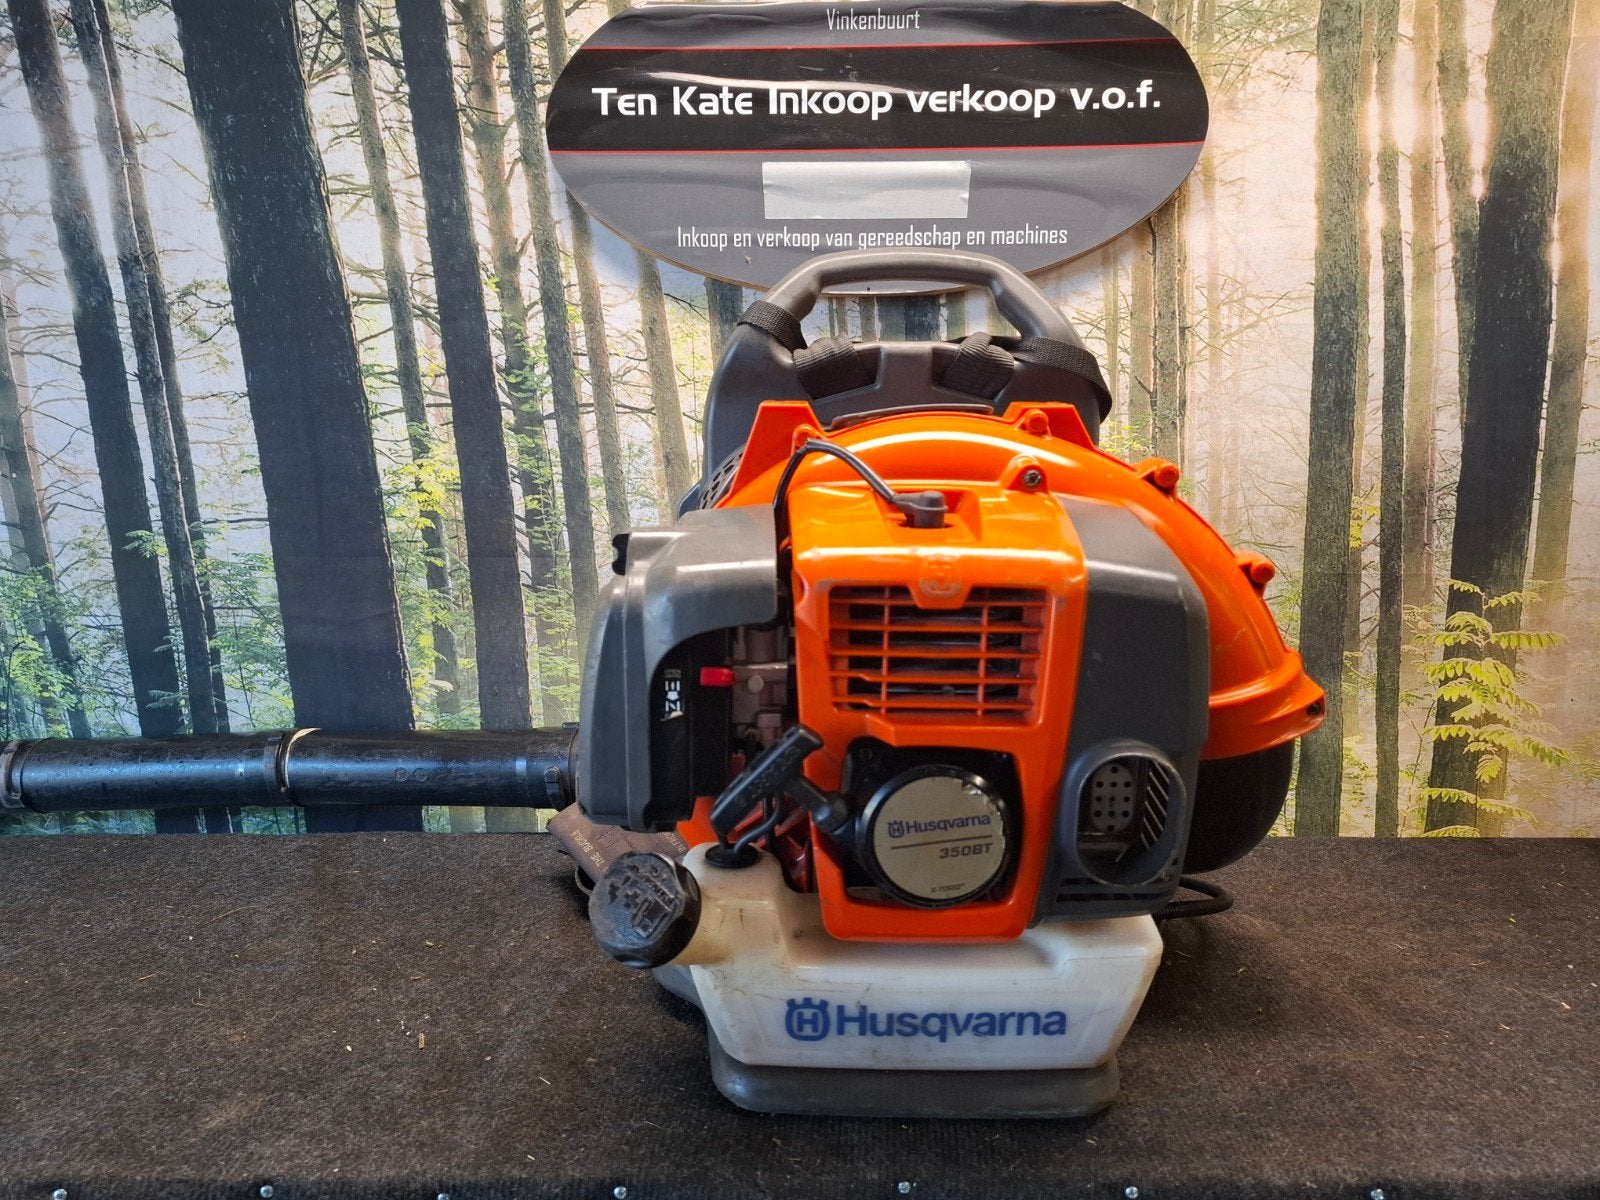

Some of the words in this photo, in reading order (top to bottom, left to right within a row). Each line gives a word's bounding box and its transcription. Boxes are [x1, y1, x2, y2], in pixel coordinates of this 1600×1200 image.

[826, 7, 920, 30] Vinkenbuurt
[591, 87, 657, 116] Ten
[672, 86, 753, 115] Kate
[768, 85, 893, 121] Inkoop
[907, 83, 1056, 118] verkoop
[1070, 79, 1161, 110] v.o.f.
[677, 226, 728, 252] Inkoop
[733, 232, 752, 247] en
[757, 226, 820, 251] verkoop
[825, 232, 853, 247] van
[858, 224, 961, 250] gereedschap
[966, 230, 985, 245] en
[990, 222, 1068, 244] machines
[905, 814, 992, 833] Husqvarna
[938, 842, 993, 860] 350BT
[836, 1004, 1067, 1043] Husqvarna
